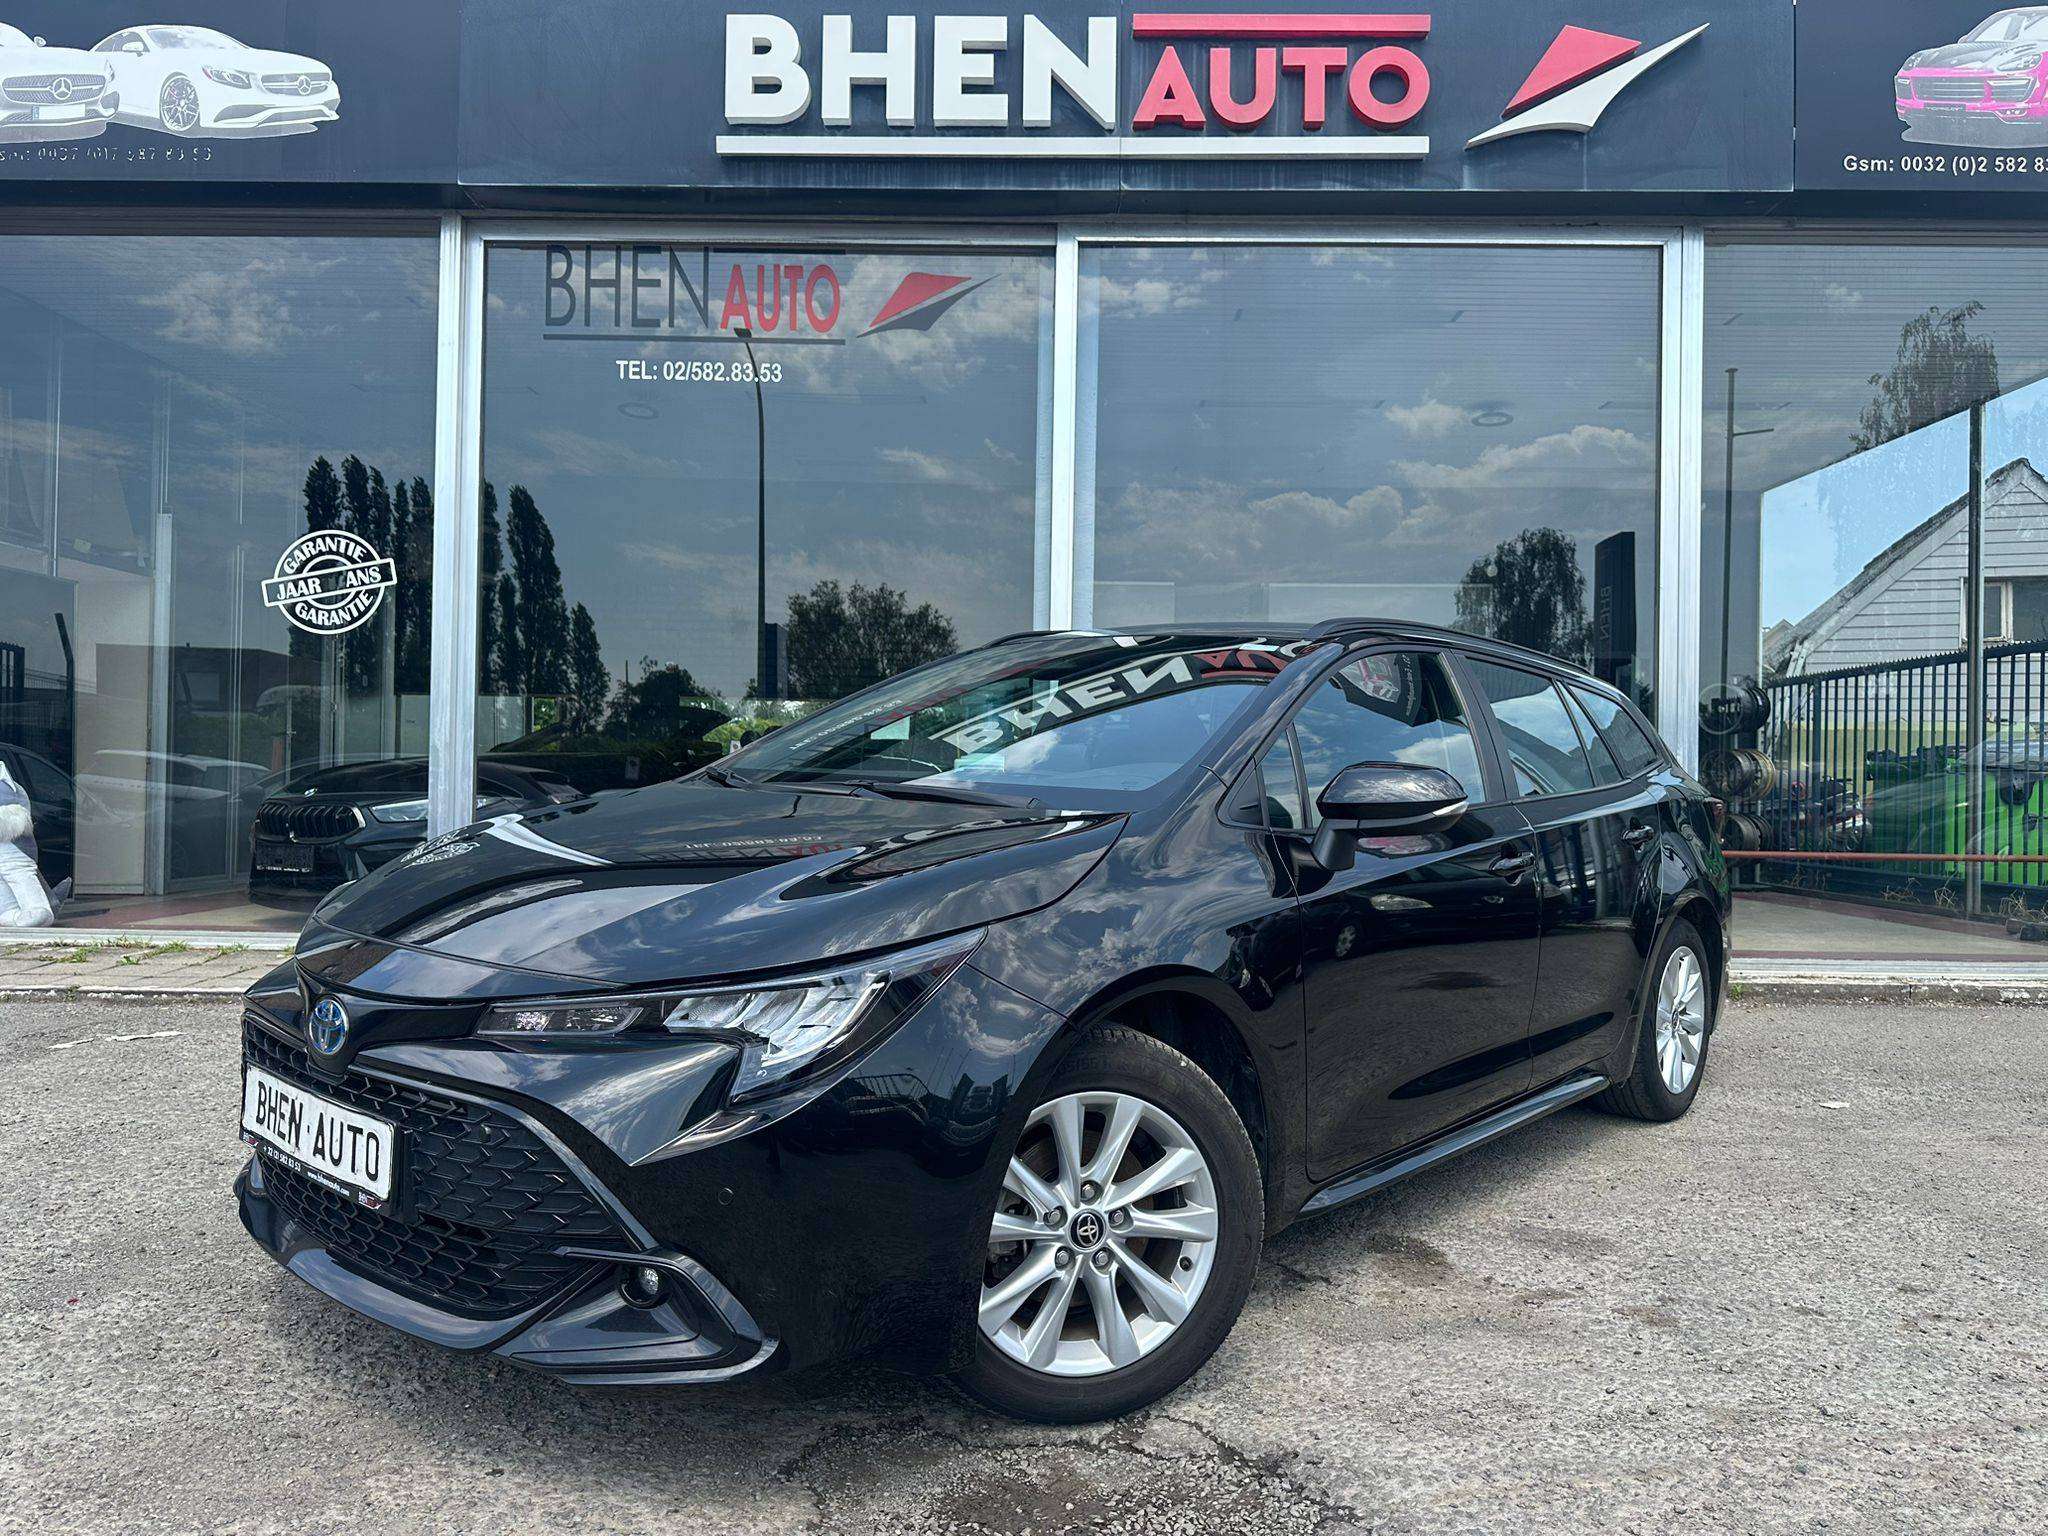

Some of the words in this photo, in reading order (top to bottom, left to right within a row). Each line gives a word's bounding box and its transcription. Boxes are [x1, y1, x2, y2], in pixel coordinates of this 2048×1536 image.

[724, 14, 1117, 129] BHEN
[1132, 45, 1430, 131] AUTO
[1843, 155, 1894, 172] Gsm:
[1900, 156, 1946, 172] 0032
[1952, 156, 1988, 176] (0)2
[1994, 157, 2028, 173] 582
[545, 244, 709, 328] BHEN
[720, 263, 841, 333] AUTO
[615, 360, 658, 381] TEL:
[663, 360, 783, 383] 02/582.83.53
[283, 536, 367, 575] GARANTIE
[276, 577, 322, 600] JAAR
[346, 566, 382, 588] ANS
[294, 590, 374, 626] GARANTIE
[255, 1080, 304, 1150] BHEN
[312, 1112, 380, 1182] AUTO
